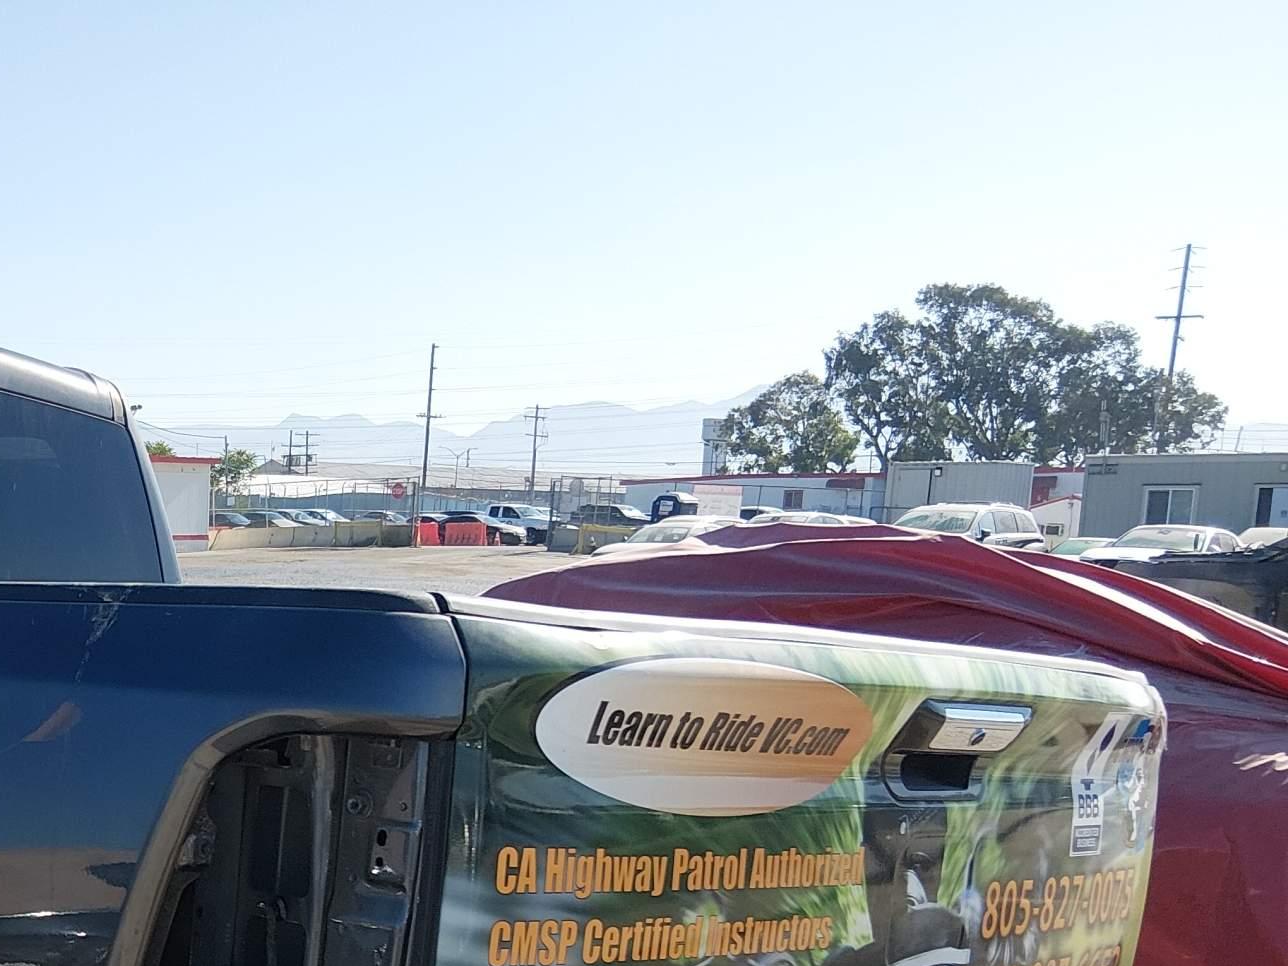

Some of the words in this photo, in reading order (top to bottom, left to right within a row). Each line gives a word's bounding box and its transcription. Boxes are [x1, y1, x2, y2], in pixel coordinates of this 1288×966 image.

[587, 701, 673, 748] Learn
[669, 712, 705, 750] to
[699, 712, 765, 752] Ride
[758, 717, 851, 757] VC.com
[1078, 794, 1099, 818] BBB
[495, 846, 538, 894] CA
[543, 847, 668, 899] Highway
[671, 848, 748, 892] Patrol
[749, 846, 866, 889] Authorized
[981, 868, 1136, 941] 805-827-0075
[581, 915, 705, 965] Certified
[705, 914, 833, 957] Instructors
